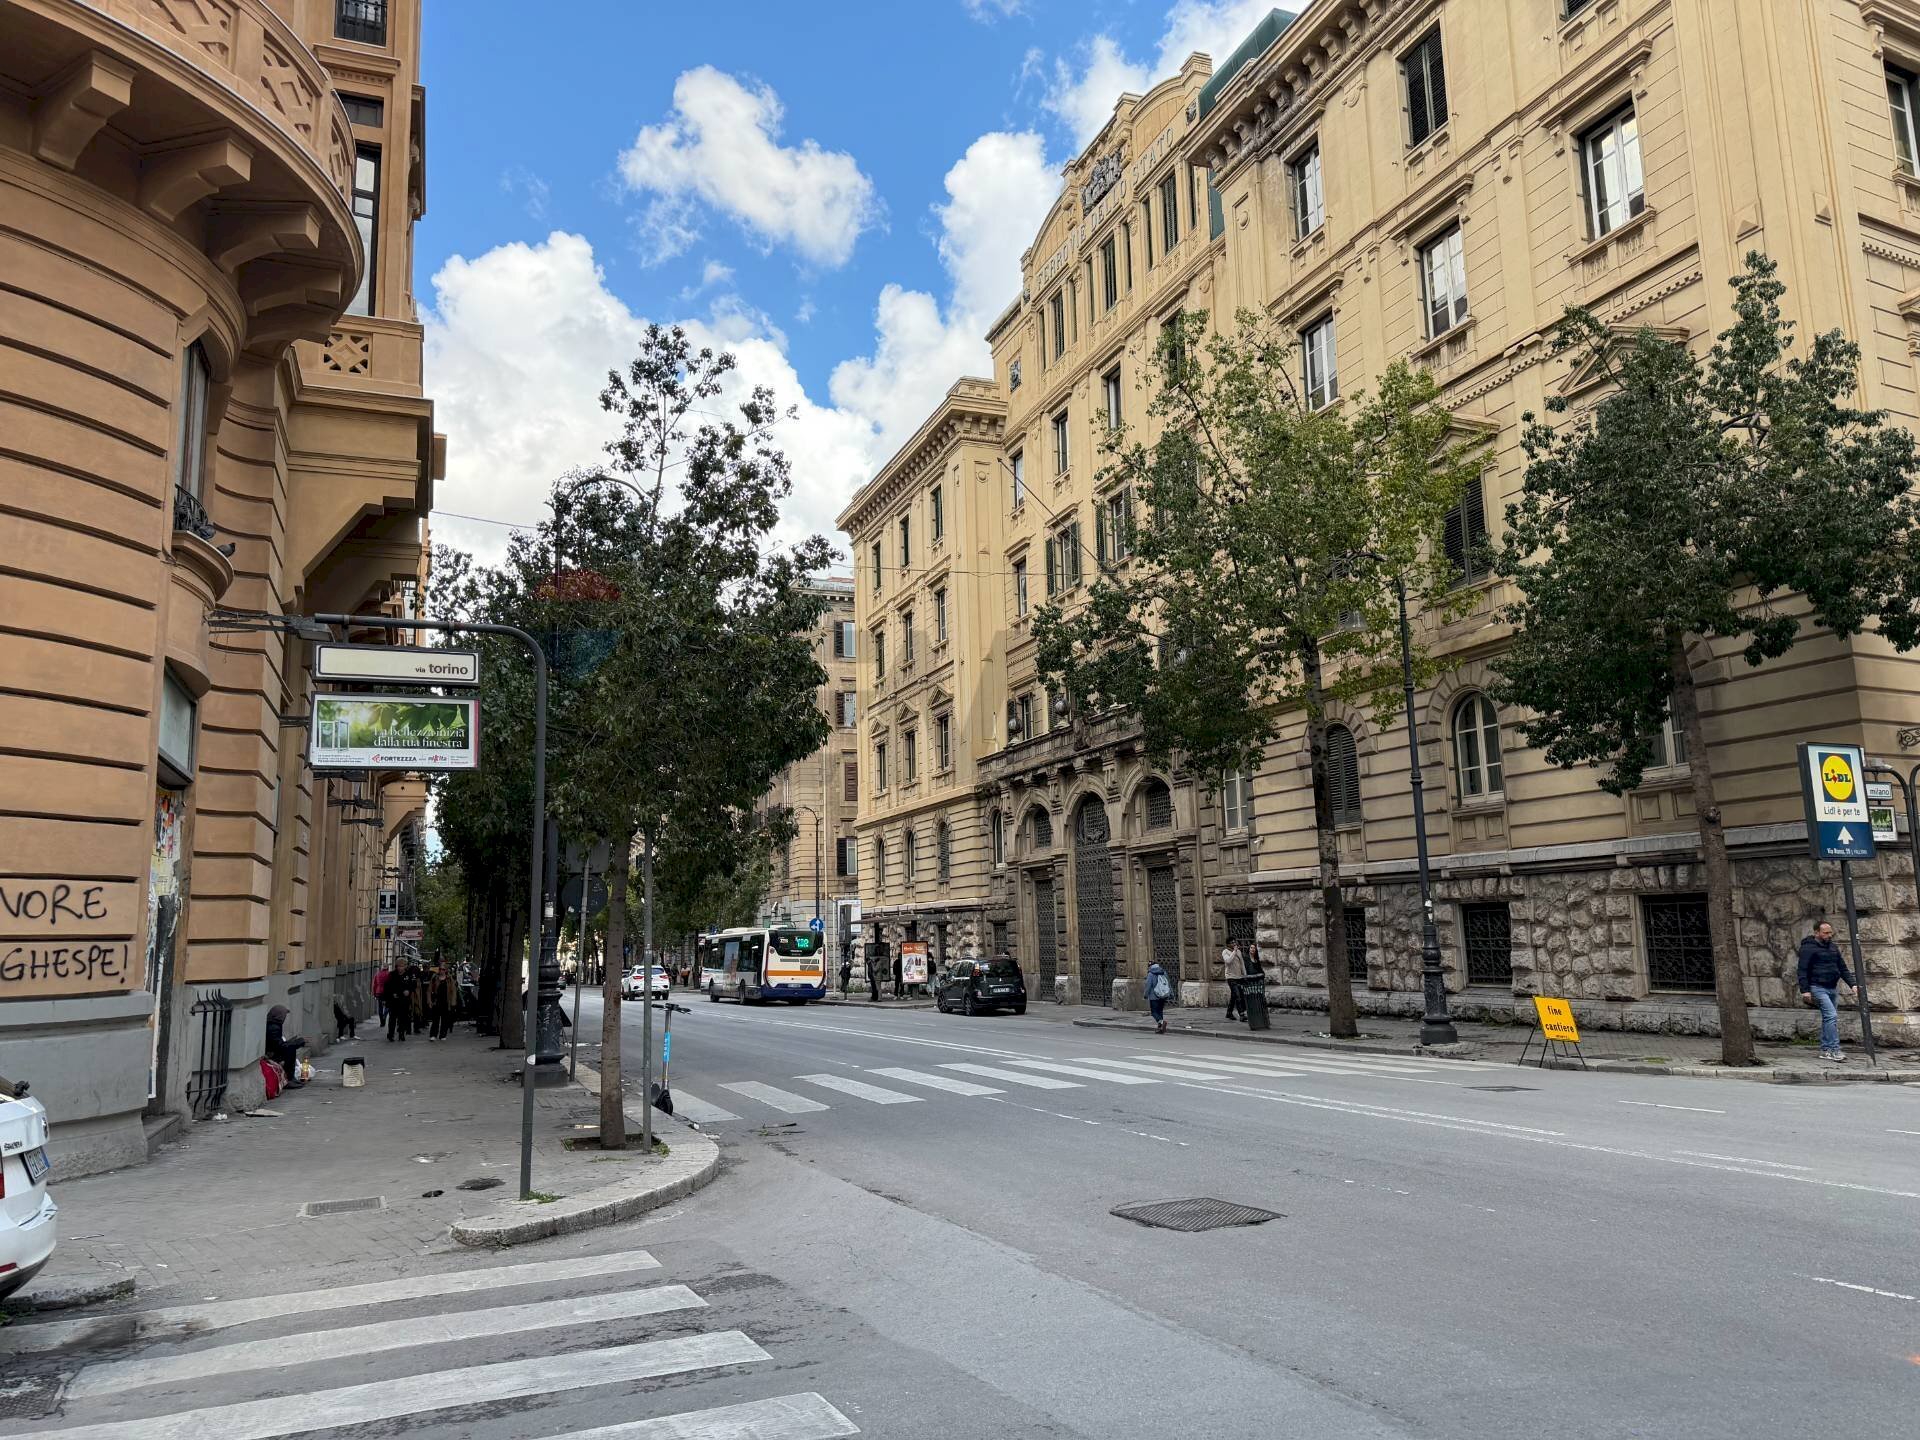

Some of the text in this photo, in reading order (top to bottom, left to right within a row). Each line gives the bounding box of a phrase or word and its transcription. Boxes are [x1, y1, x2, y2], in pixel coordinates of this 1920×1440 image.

[1132, 127, 1174, 187] STATO
[429, 663, 469, 676] torino
[373, 735, 463, 748] dalla tua finestra
[1869, 788, 1890, 796] milano
[1824, 806, 1836, 815] Lidl
[1843, 809, 1853, 817] per
[1854, 807, 1861, 816] te
[1547, 1005, 1562, 1016] fine
[1545, 1022, 1575, 1033] cantiere
